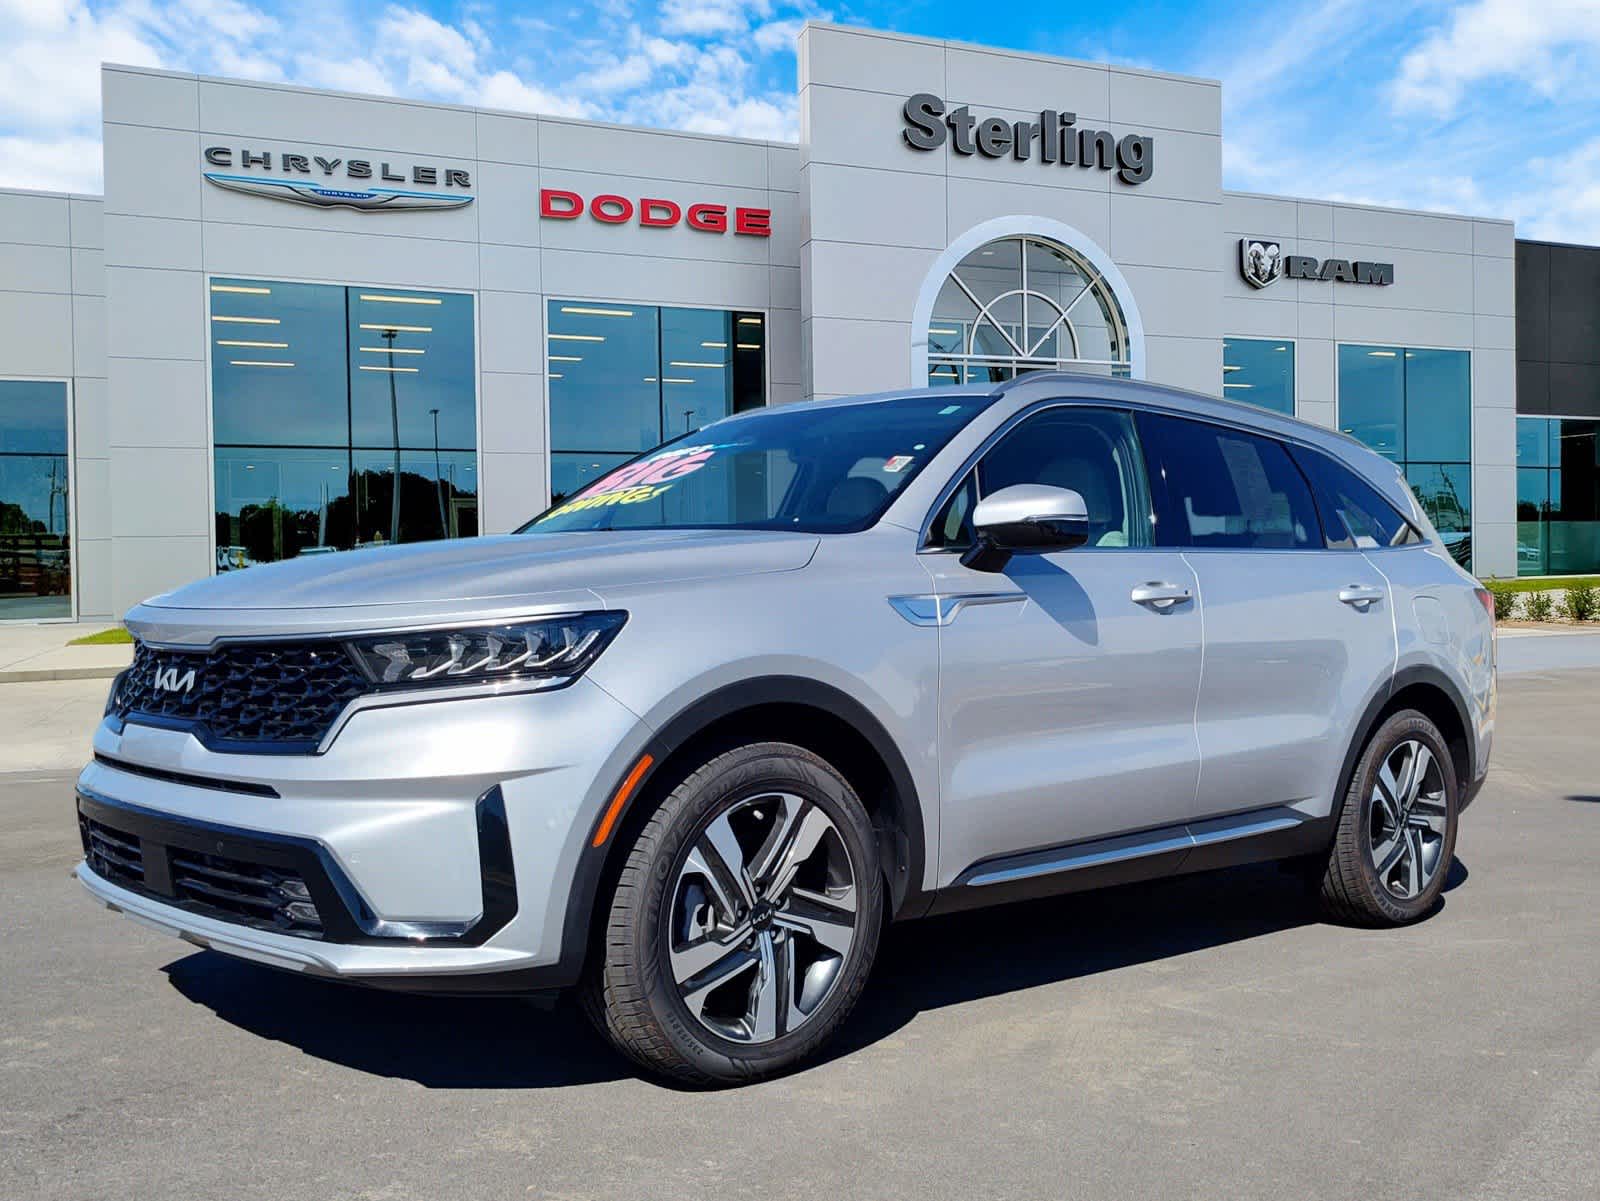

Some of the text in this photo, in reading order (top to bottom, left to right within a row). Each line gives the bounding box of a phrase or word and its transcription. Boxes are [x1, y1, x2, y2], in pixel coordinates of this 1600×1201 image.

[903, 93, 1154, 186] Sterling
[204, 146, 472, 188] CHRYSLER
[315, 190, 369, 198] CHRYSLER
[540, 188, 771, 238] DODGE
[1285, 255, 1394, 286] RAM
